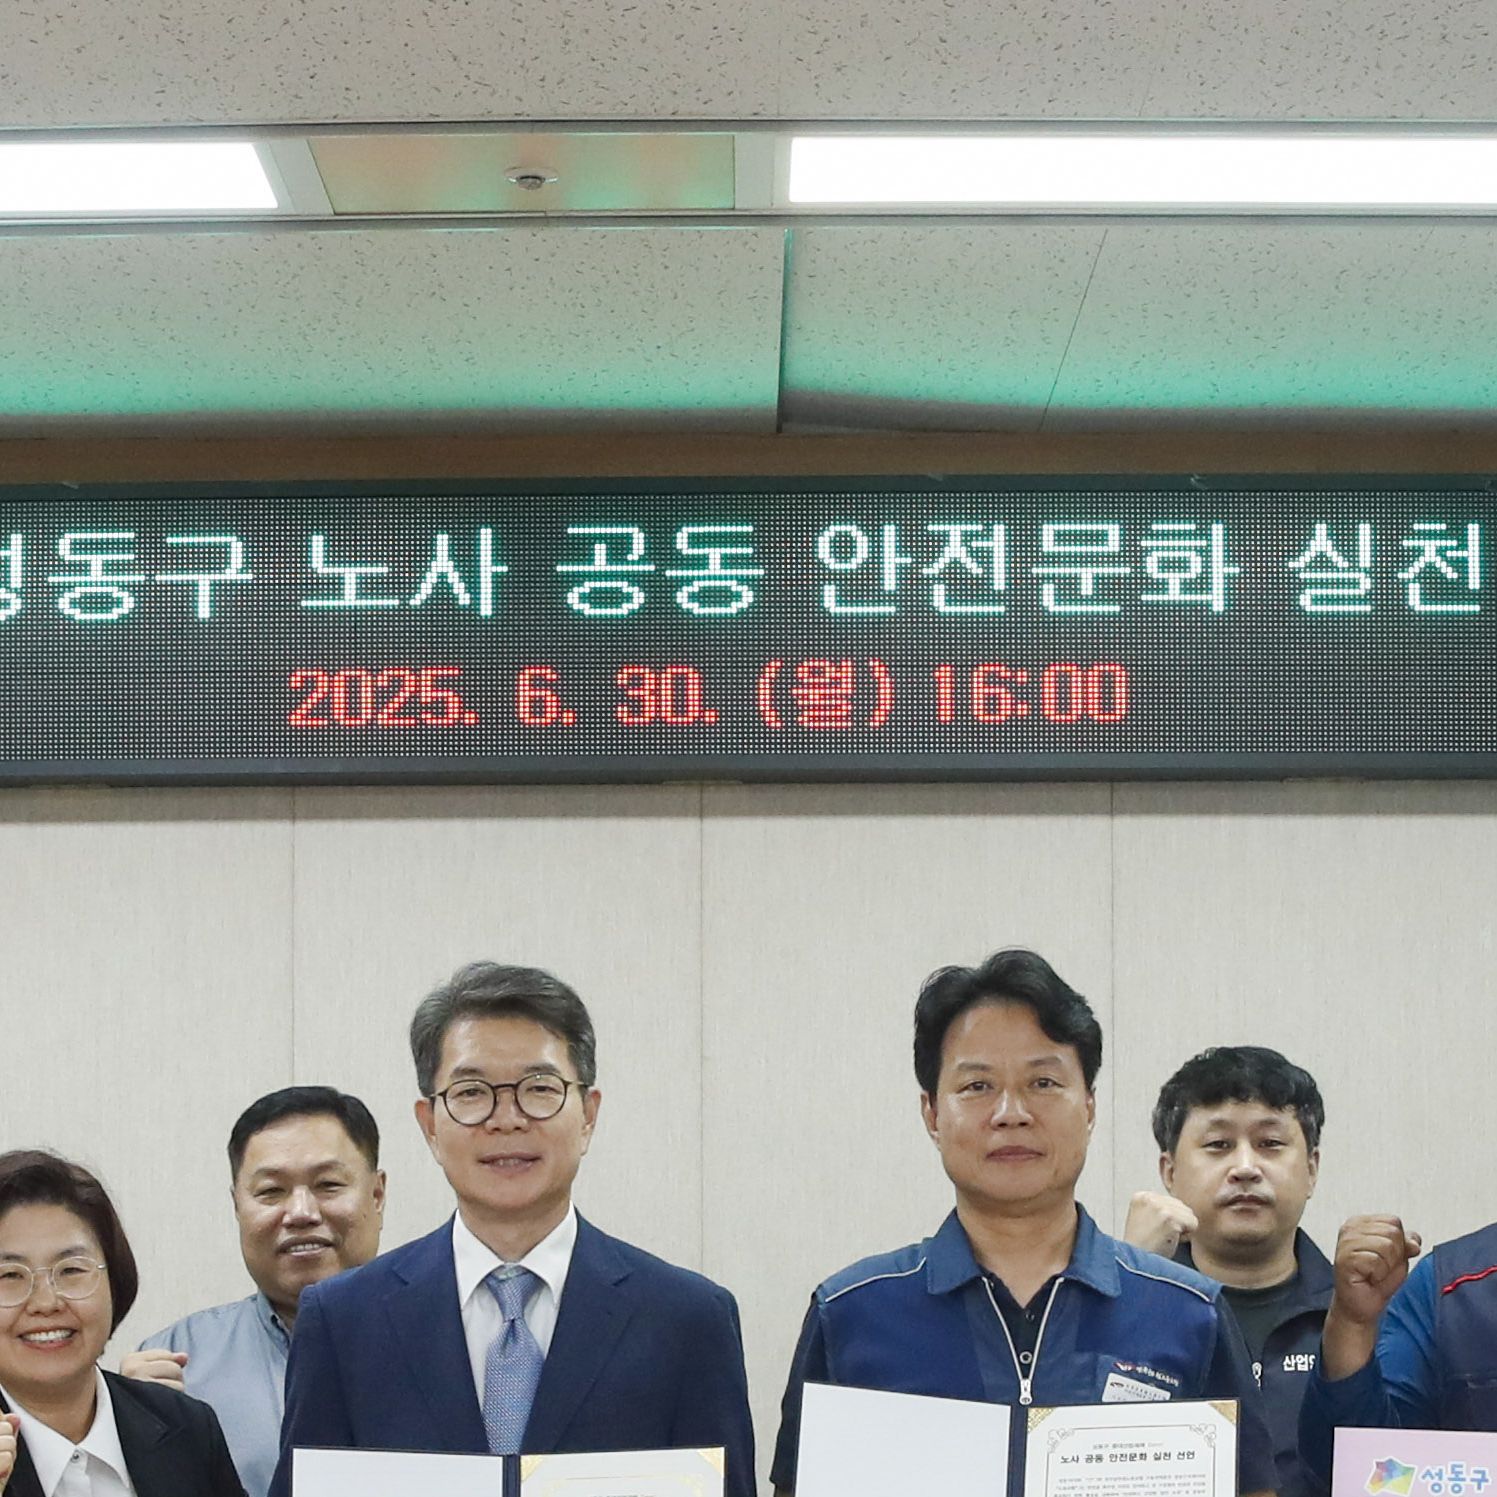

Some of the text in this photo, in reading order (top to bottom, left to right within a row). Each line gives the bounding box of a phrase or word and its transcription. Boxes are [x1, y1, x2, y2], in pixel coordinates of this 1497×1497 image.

[299, 526, 509, 619] 노사
[555, 523, 755, 617] 공동
[815, 521, 1241, 615] 안전문화
[1286, 521, 1483, 615] 실천
[289, 658, 1130, 728] 2025. 6. 30. (월) 16:00
[1060, 1450, 1195, 1464] 노사 공동 안전문화 실천 선언
[1421, 1463, 1490, 1494] 성동구
